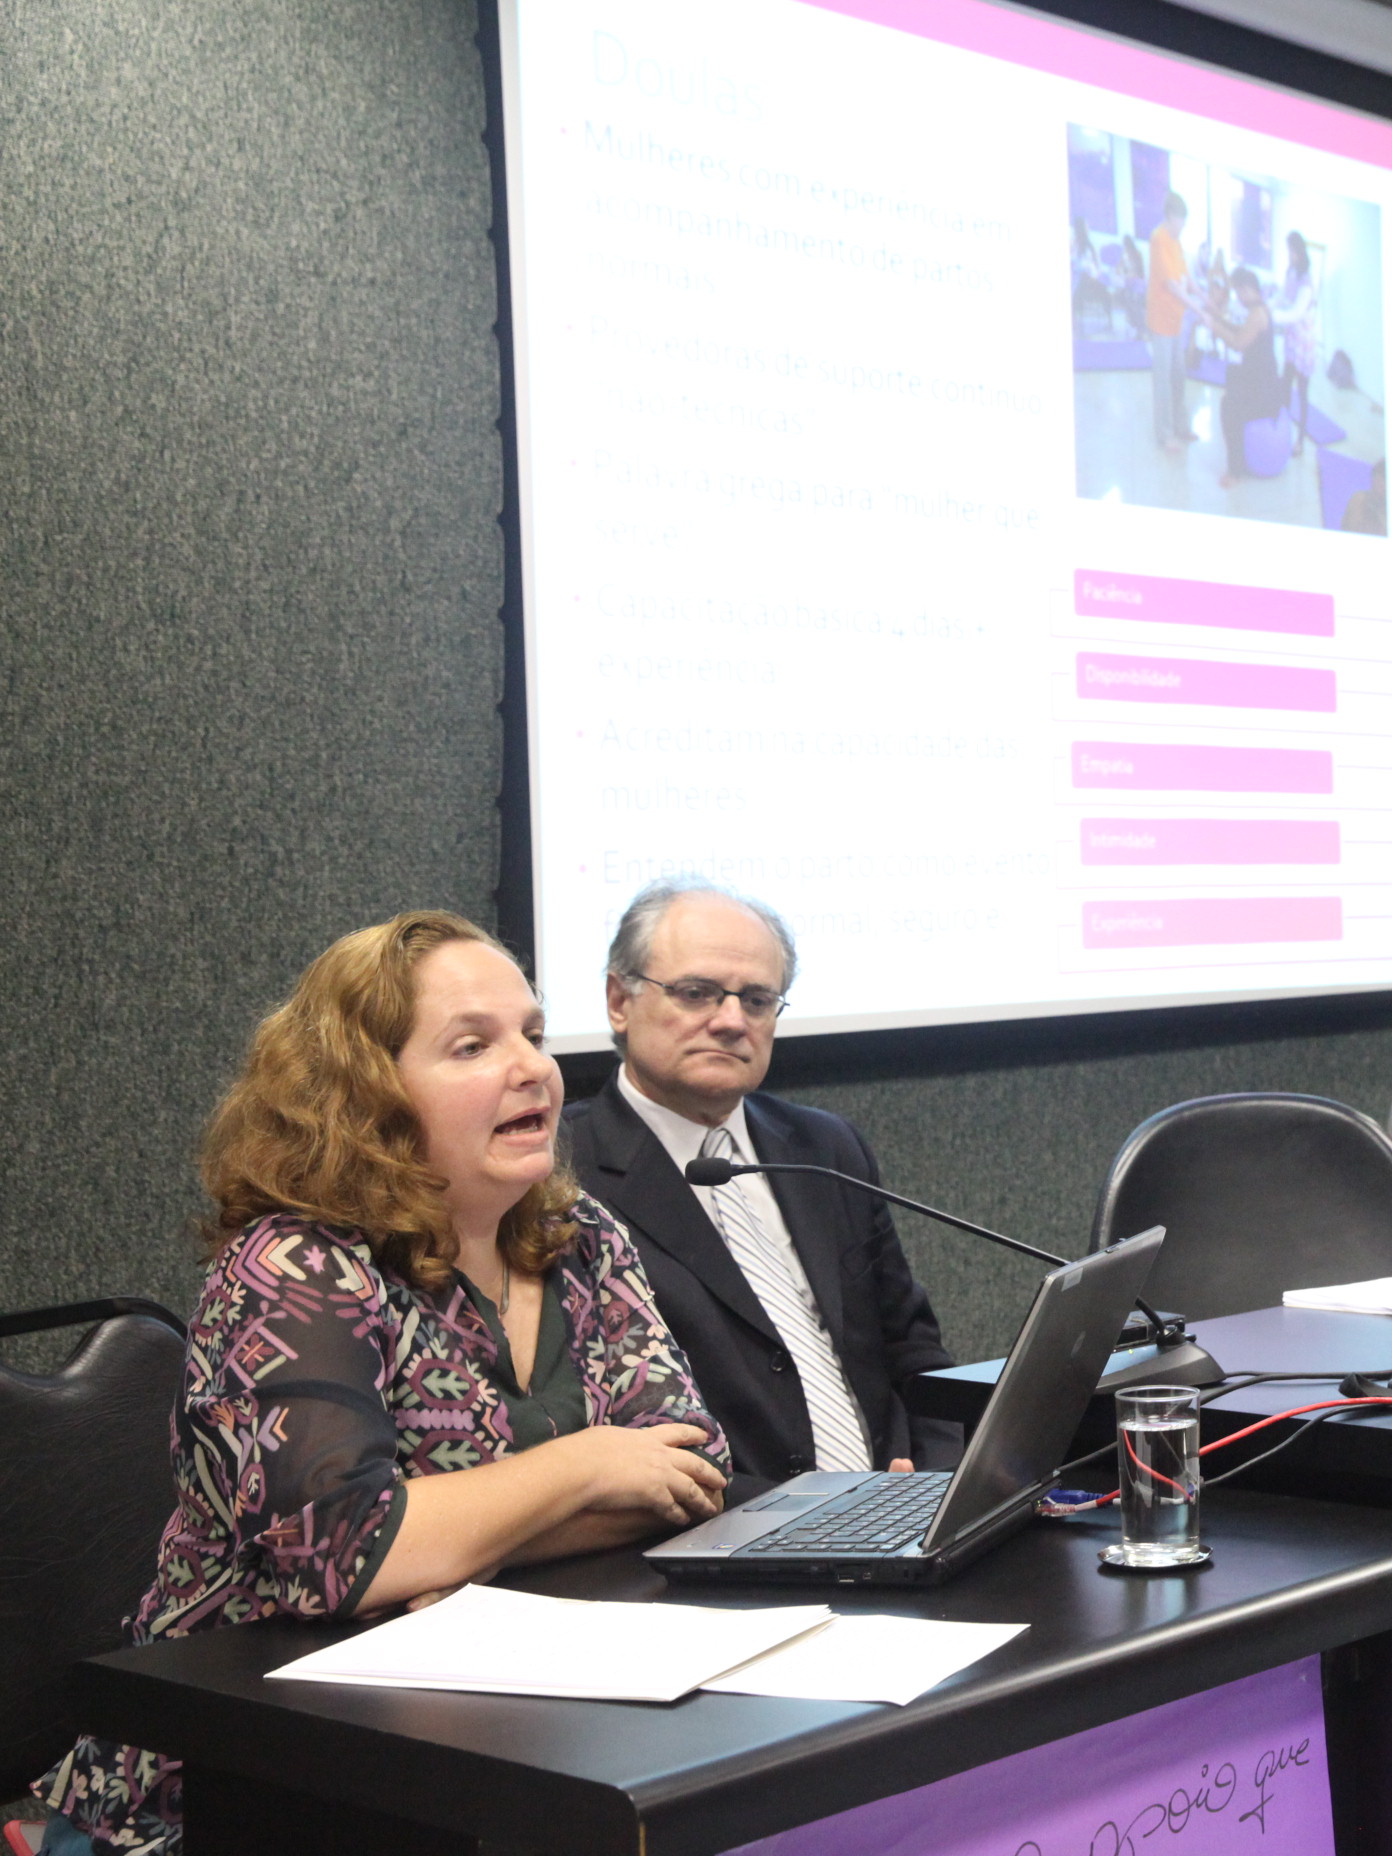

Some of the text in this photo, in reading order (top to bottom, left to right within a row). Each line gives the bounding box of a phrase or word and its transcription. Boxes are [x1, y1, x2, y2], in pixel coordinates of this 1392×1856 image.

[592, 28, 765, 123] Doulas
[584, 119, 732, 184] Mulheres
[738, 162, 802, 198] com
[585, 189, 995, 294] acompanhamento de partos
[774, 346, 809, 380] de
[817, 359, 923, 399] suporte
[812, 482, 874, 514] para
[600, 775, 750, 812] mulheres
[1238, 1737, 1311, 1835] que
